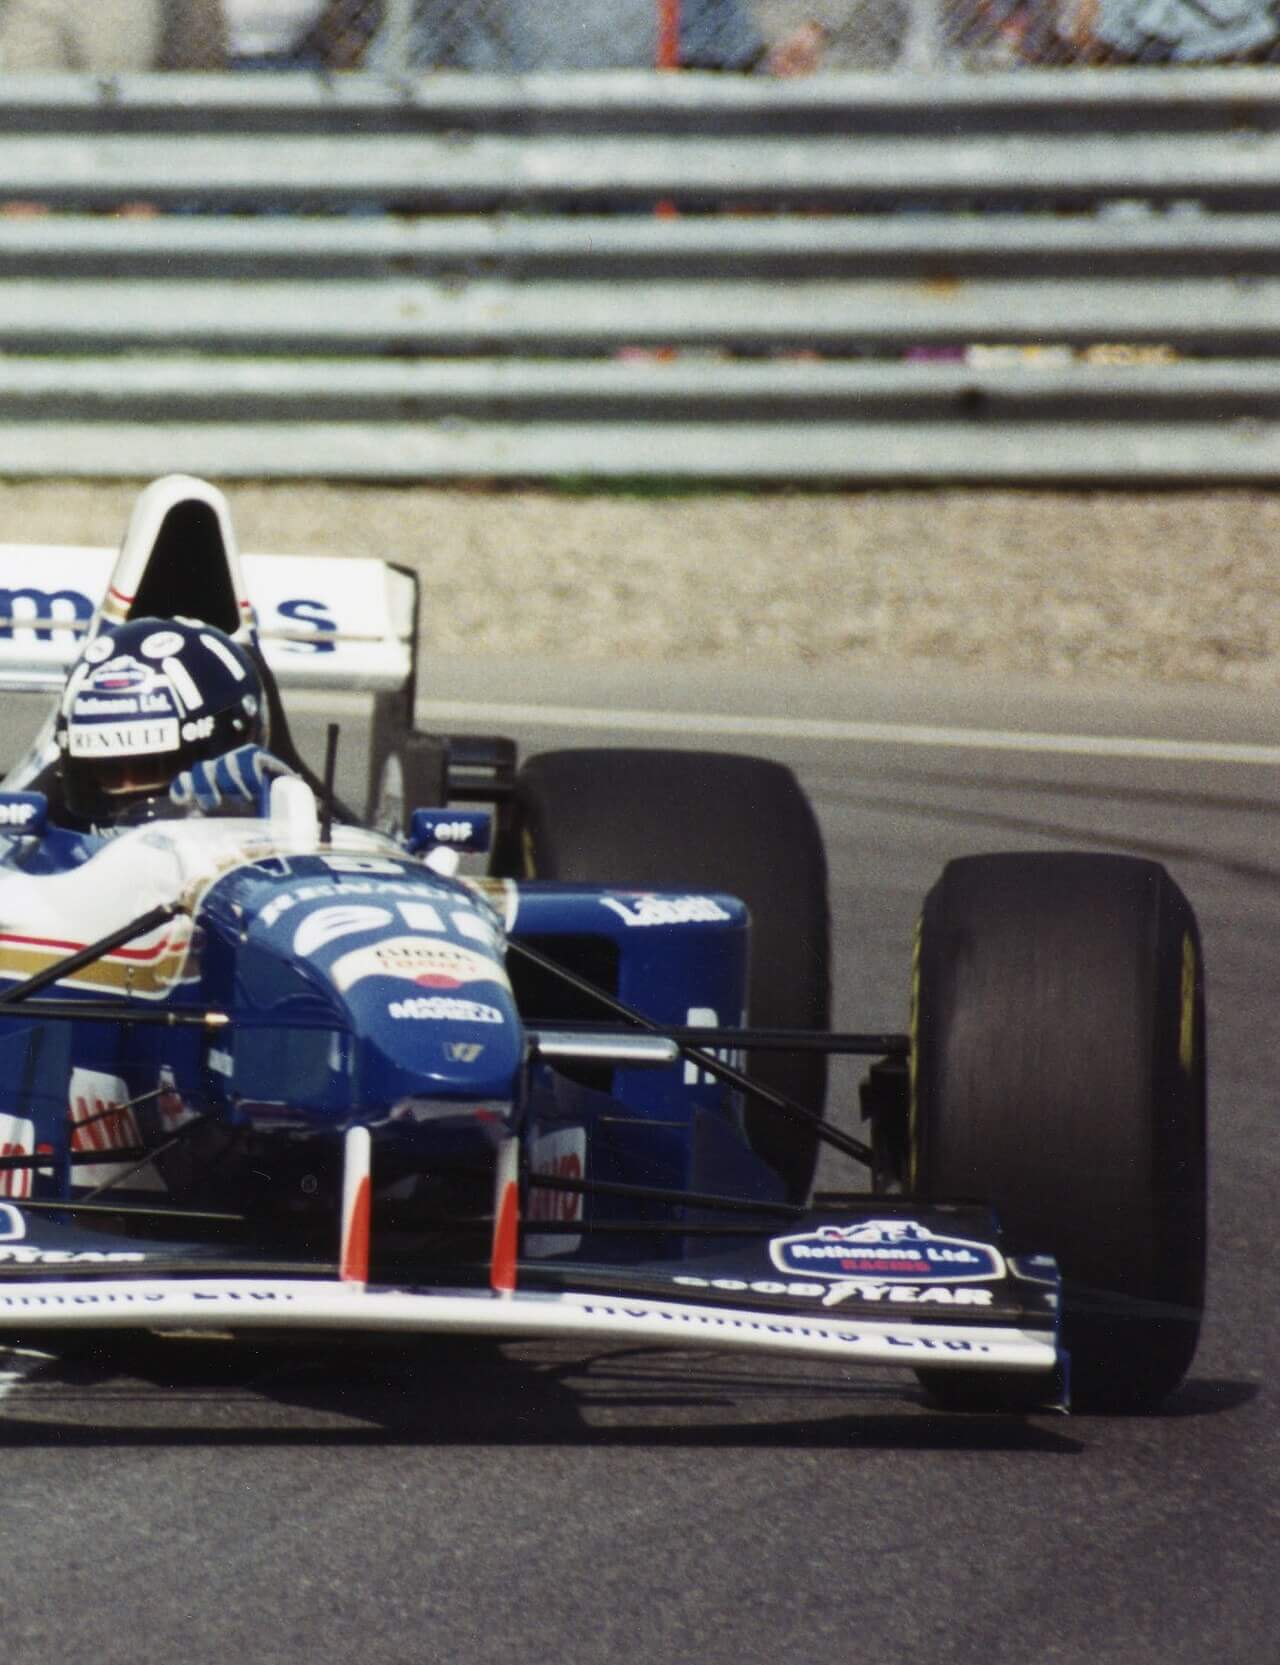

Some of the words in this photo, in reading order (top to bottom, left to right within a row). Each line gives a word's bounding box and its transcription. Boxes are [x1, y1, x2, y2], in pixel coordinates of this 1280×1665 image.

[434, 821, 473, 842] elf
[790, 1245, 923, 1259] Rothmans
[927, 1247, 979, 1263] Ltd.
[673, 1276, 994, 1306] GOODYEAR
